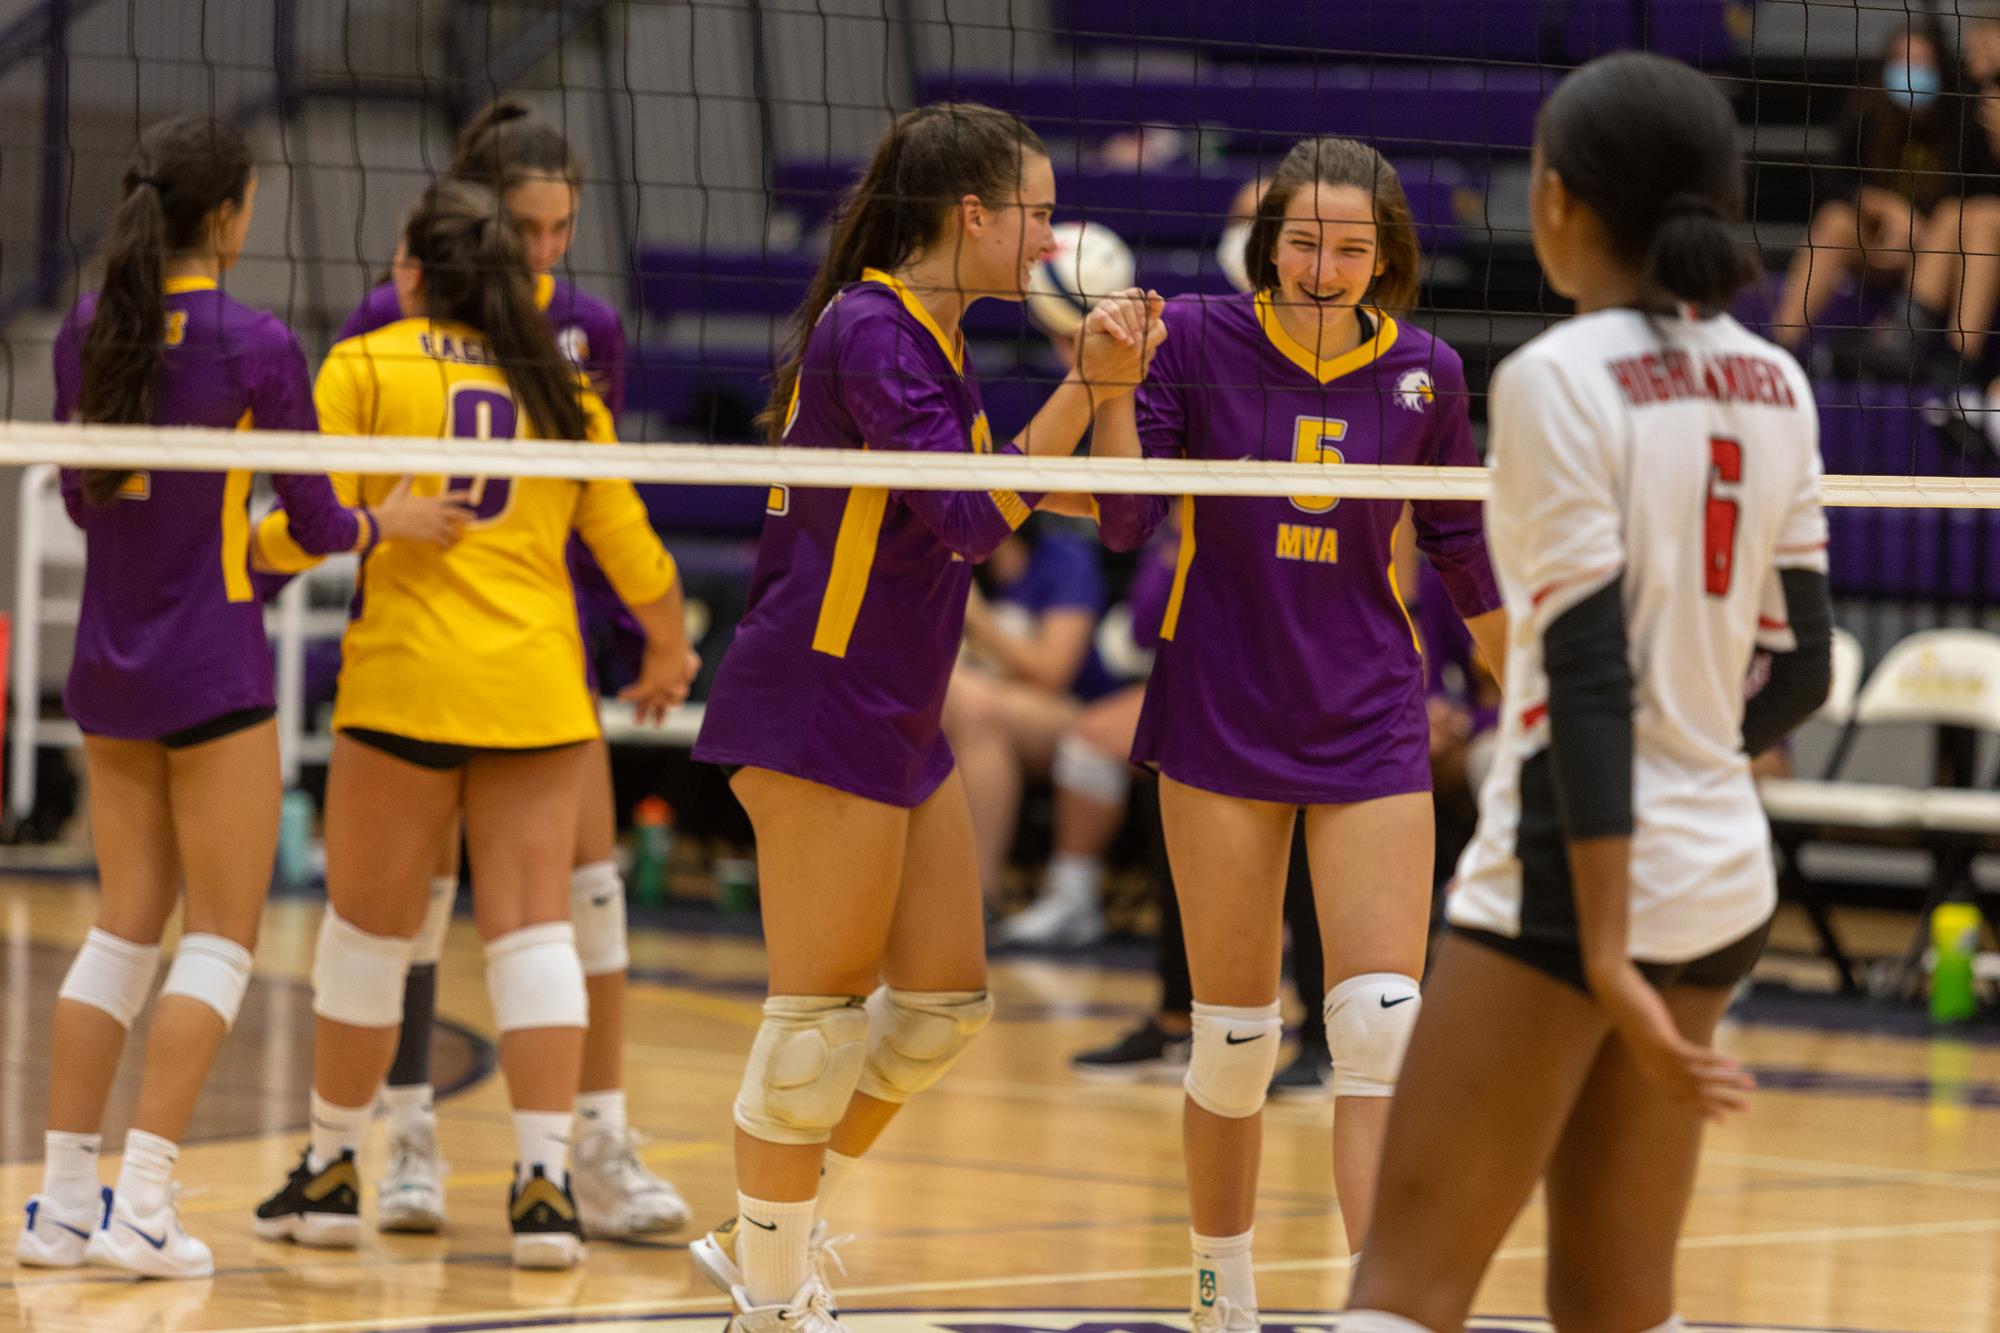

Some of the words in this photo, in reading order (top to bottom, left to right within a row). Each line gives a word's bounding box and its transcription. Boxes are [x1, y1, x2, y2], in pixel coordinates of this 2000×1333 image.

[419, 331, 502, 368] EAGL
[1288, 415, 1349, 514] 5
[1275, 522, 1339, 564] MVA
[1703, 435, 1743, 597] 6
